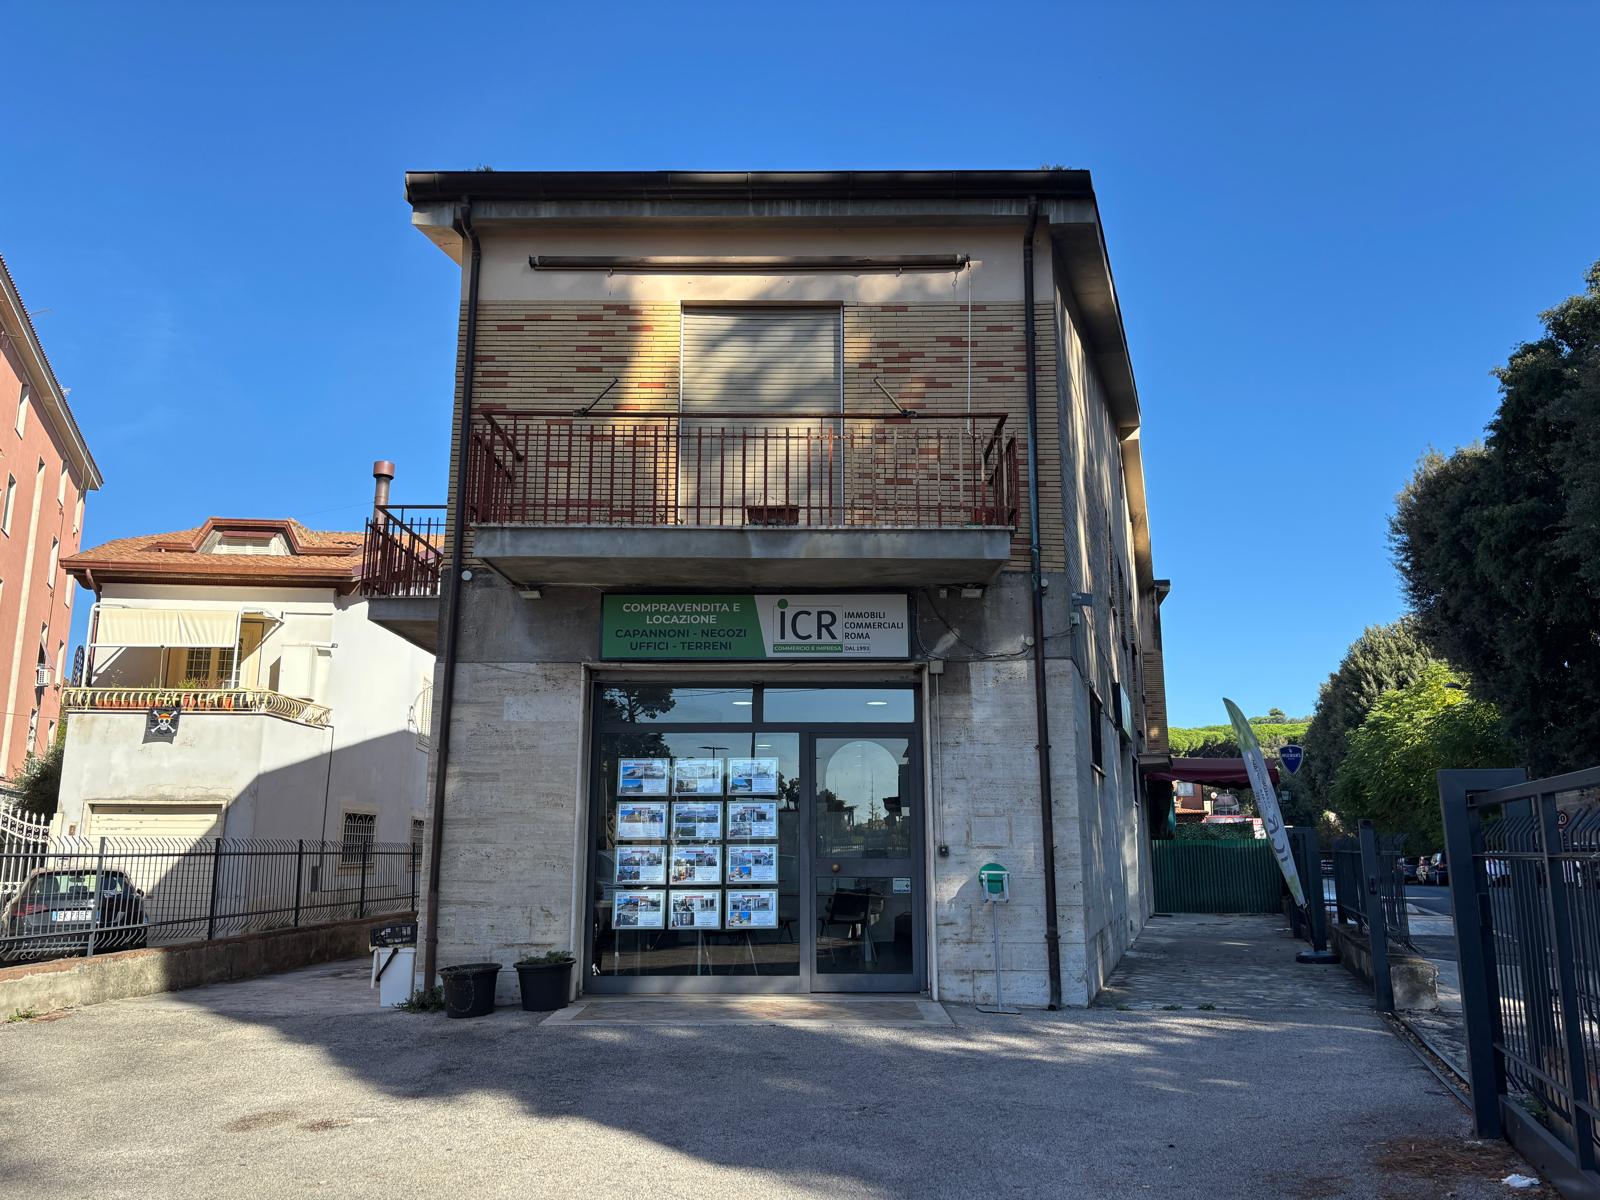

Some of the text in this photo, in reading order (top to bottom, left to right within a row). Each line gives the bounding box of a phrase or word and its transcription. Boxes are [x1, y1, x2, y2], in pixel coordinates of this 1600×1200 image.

[622, 603, 741, 613] COMPRAVENDITA E
[646, 615, 717, 624] LOCAZIONE
[844, 611, 886, 619] IMMOBILI
[844, 621, 904, 629] COMMERCIALI
[615, 628, 689, 639] CAPANNONI
[701, 628, 747, 638] NEGOZI
[844, 632, 871, 640] ROMA
[630, 641, 669, 651] UFFICI
[680, 641, 732, 650] TERRENI
